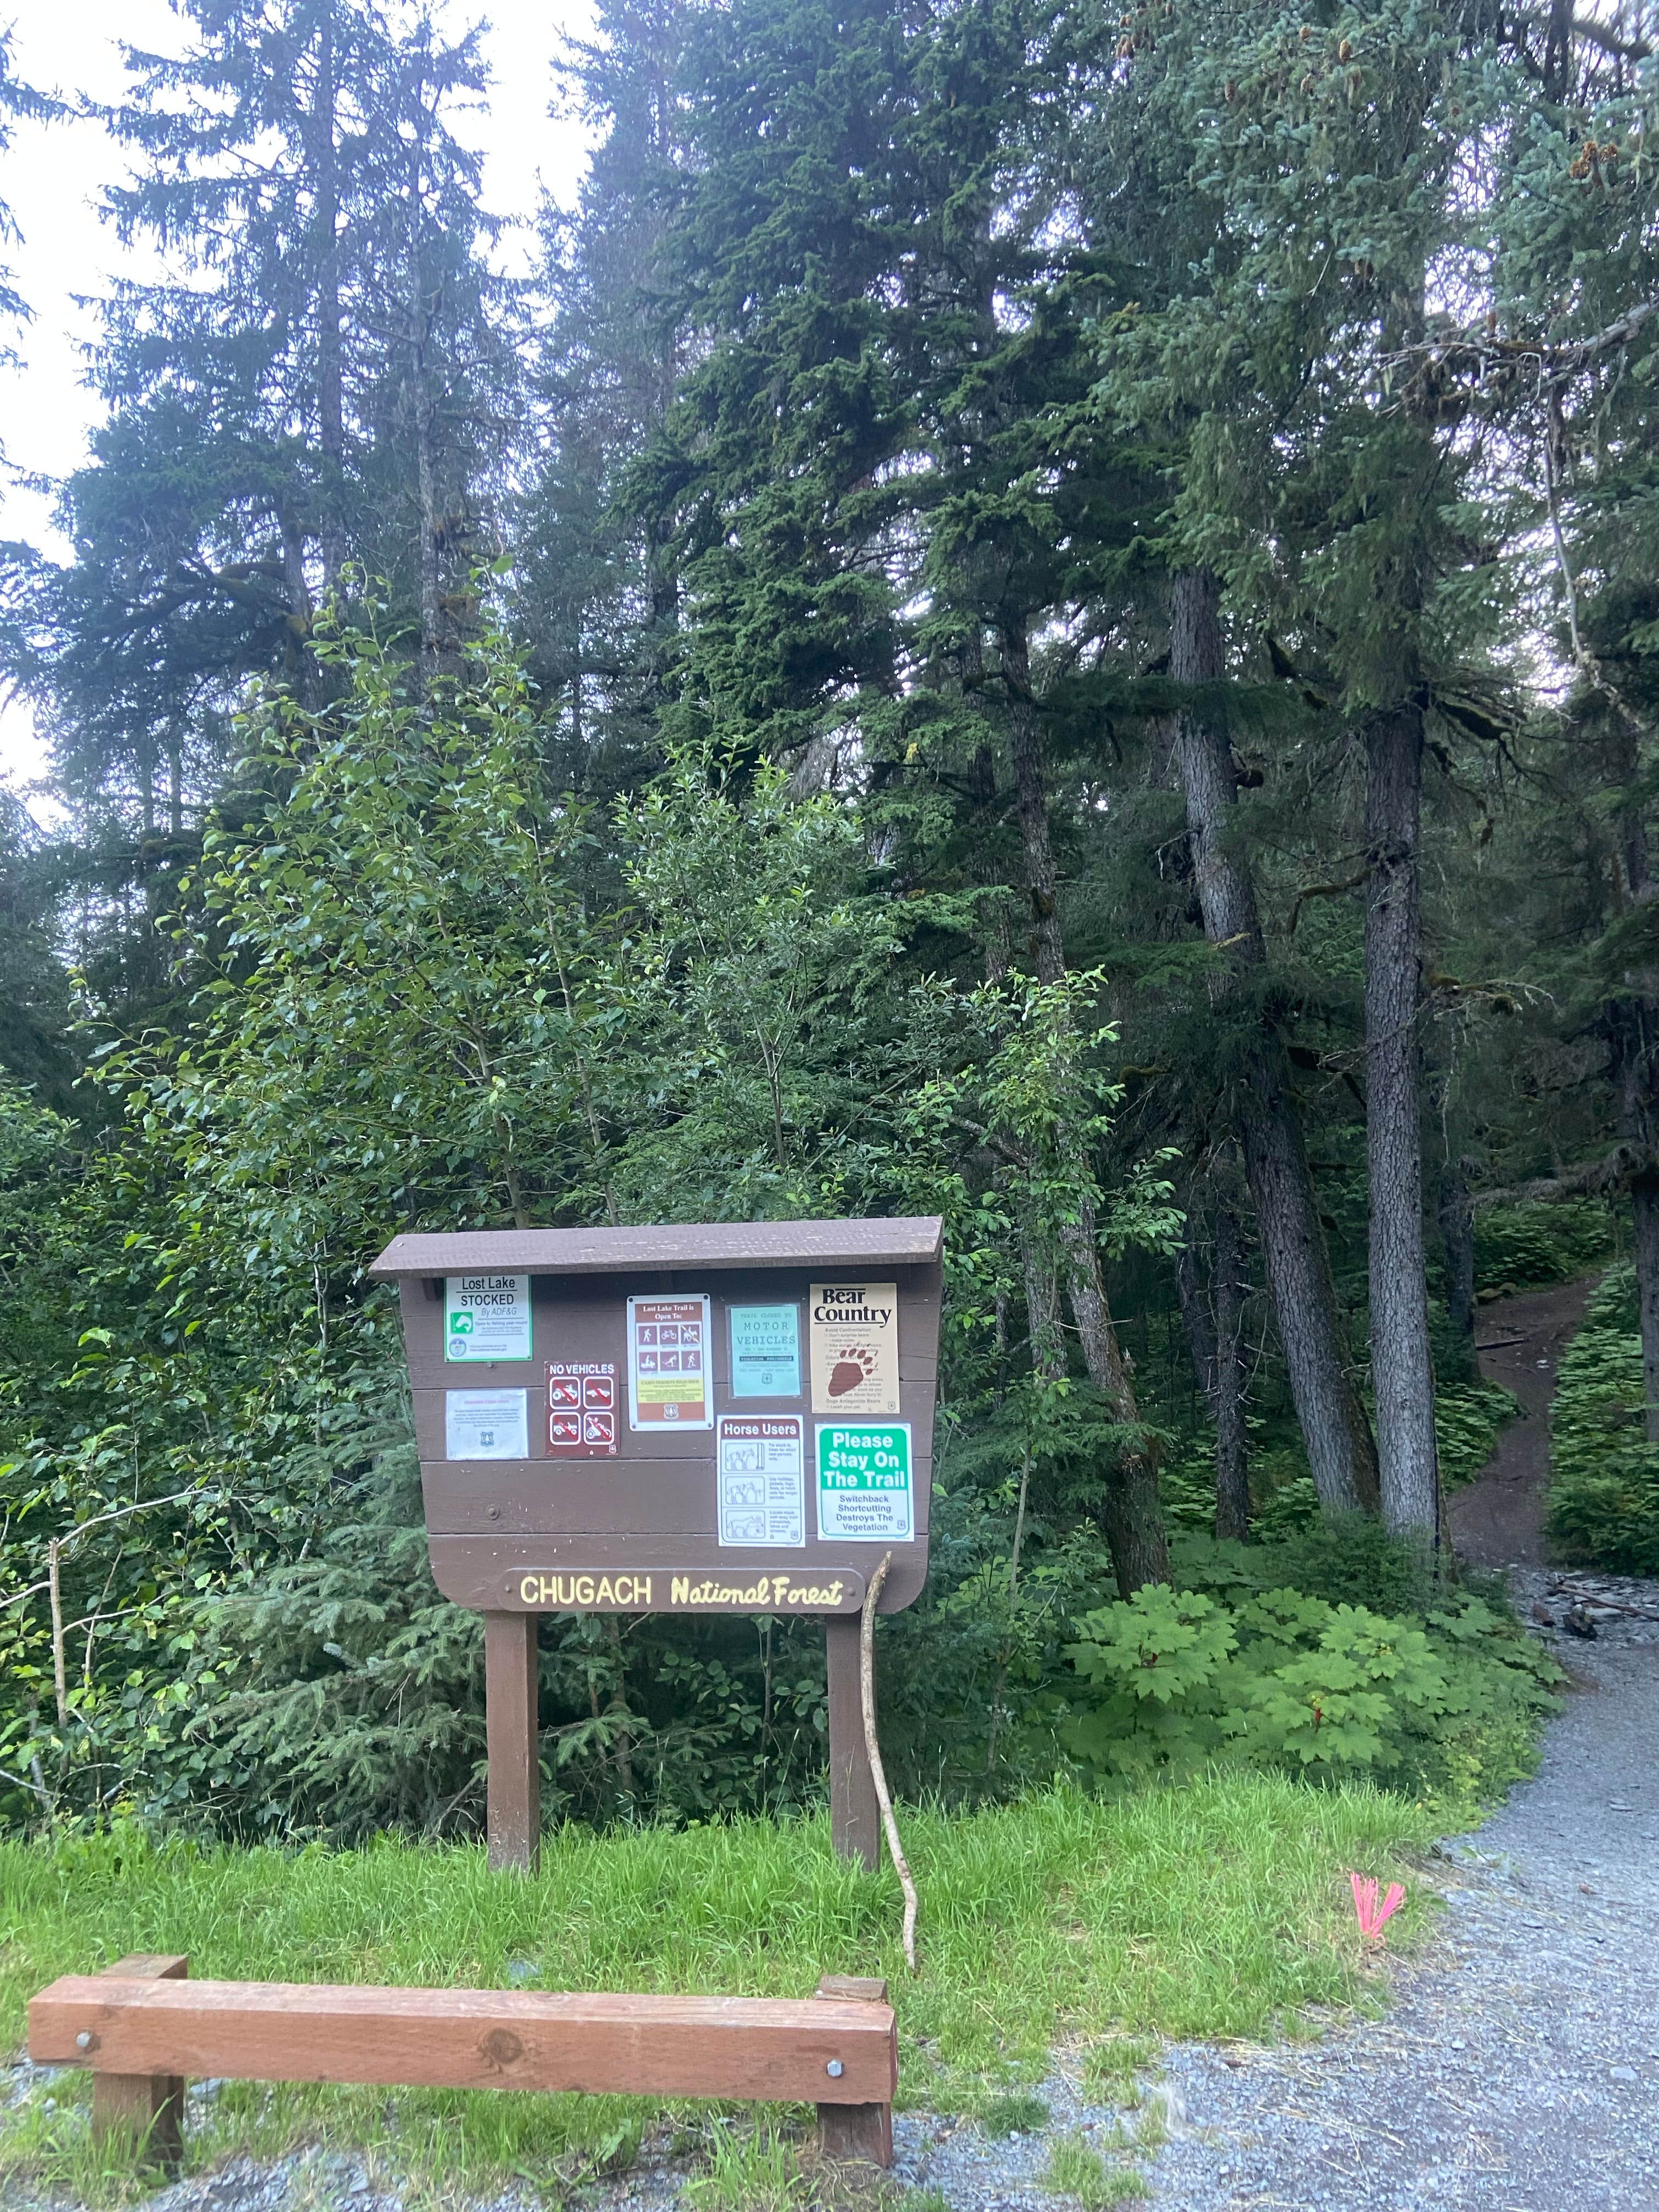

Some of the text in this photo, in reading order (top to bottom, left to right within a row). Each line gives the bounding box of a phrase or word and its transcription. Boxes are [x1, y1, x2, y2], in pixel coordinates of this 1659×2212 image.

[462, 1277, 515, 1290] Lost Lake
[461, 1294, 514, 1306] STOCKED
[823, 1289, 866, 1304] Bear
[482, 1308, 490, 1317] By
[814, 1306, 892, 1328] Country
[744, 1322, 788, 1330] MOTOR
[737, 1336, 795, 1344] VEHICLES
[550, 1364, 614, 1374] NO VEHICLES
[724, 1423, 797, 1435] Horse Users
[832, 1432, 893, 1448] Please
[828, 1451, 899, 1470] Stay On
[823, 1470, 905, 1487] The Trail
[838, 1504, 891, 1513] Shortcutting
[836, 1514, 874, 1522] Destroys
[843, 1523, 888, 1532] Vegetation
[520, 1576, 843, 1606] CHUGACH National Forest
